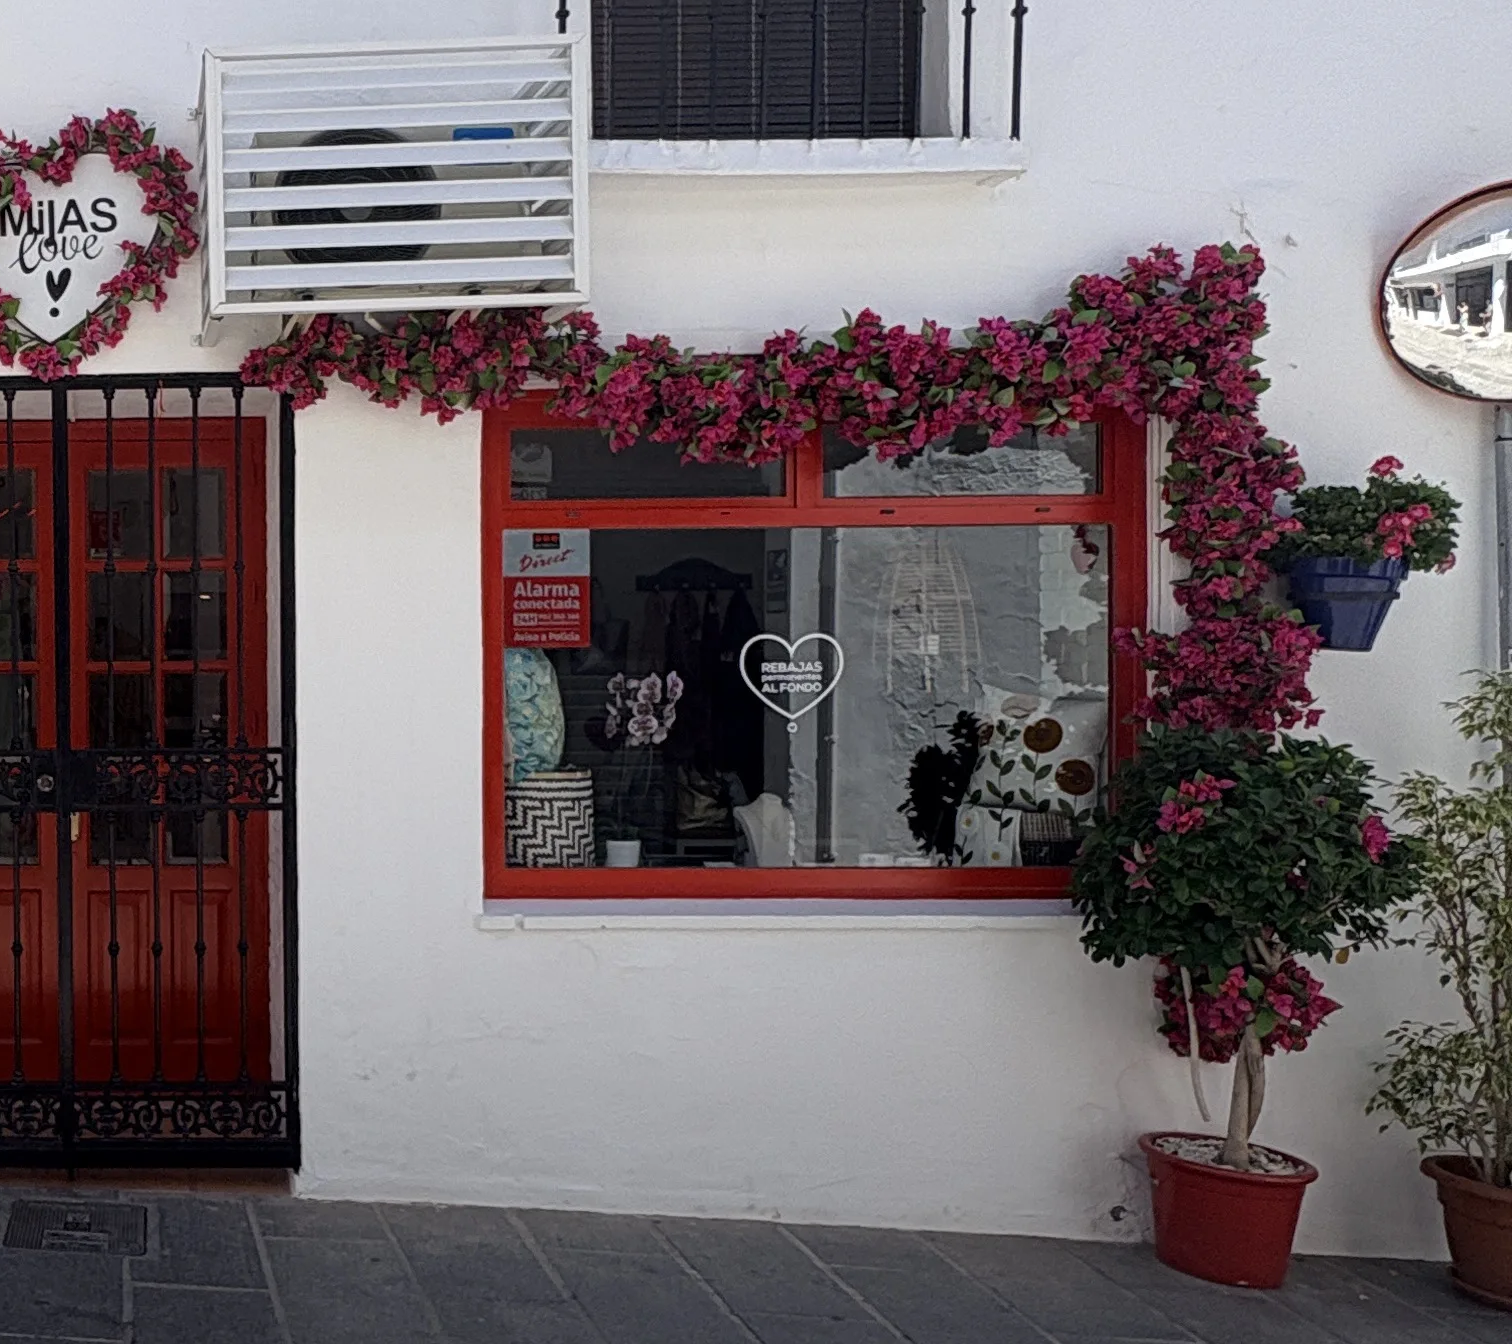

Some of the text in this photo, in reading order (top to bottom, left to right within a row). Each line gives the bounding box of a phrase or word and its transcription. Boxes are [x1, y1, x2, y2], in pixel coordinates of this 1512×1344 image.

[8, 227, 105, 274] love
[519, 548, 576, 573] Direct
[514, 580, 580, 597] Alarma
[513, 597, 581, 610] conectada
[761, 661, 823, 673] REBAJAS
[761, 682, 822, 694] AL FONDO
